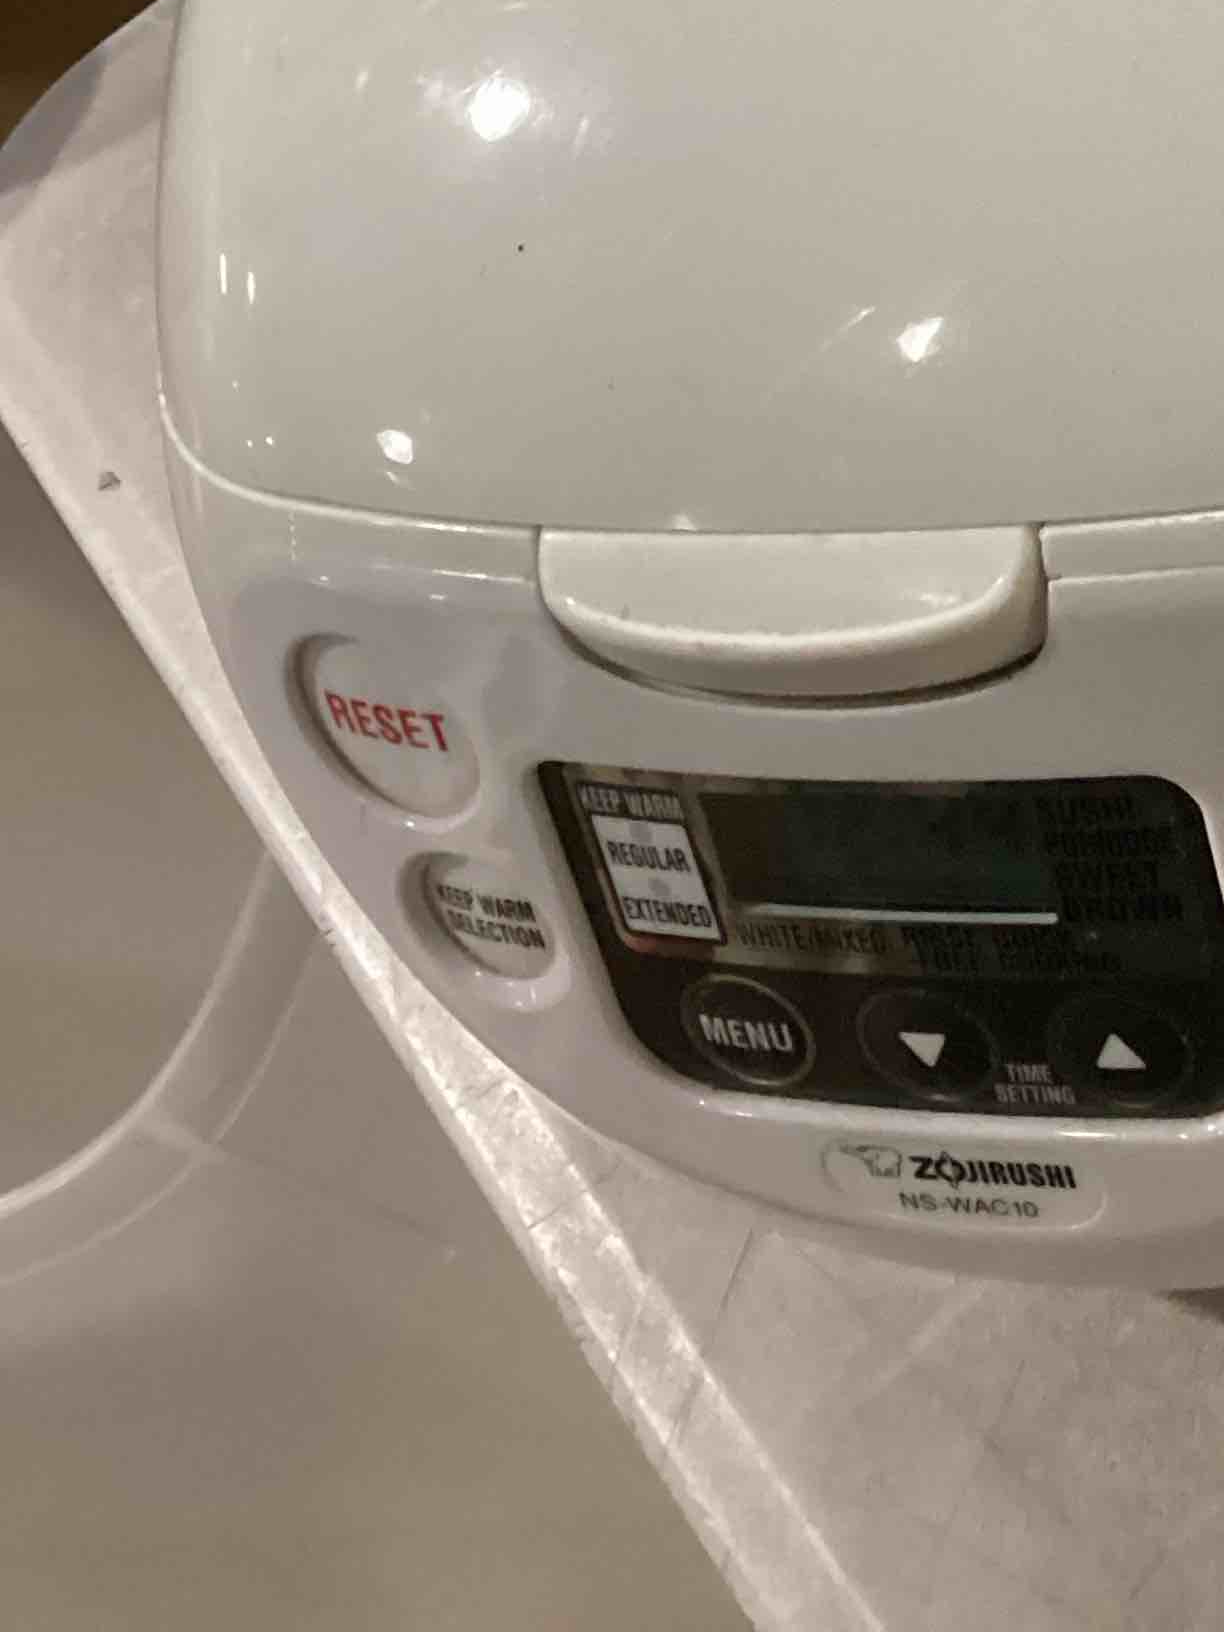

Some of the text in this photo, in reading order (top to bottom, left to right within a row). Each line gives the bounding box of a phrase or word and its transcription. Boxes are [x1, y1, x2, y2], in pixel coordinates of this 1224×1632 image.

[324, 689, 449, 752] RESET
[607, 841, 691, 874] REGULAR
[476, 894, 537, 922] WARM
[622, 896, 713, 929] EXTENDED
[446, 909, 546, 951] SELECTION
[700, 1014, 794, 1053] MENU
[993, 1084, 1077, 1105] SETTING
[909, 1151, 1078, 1190] ZOJIRUSHI
[899, 1191, 1040, 1219] NS-WAC10
